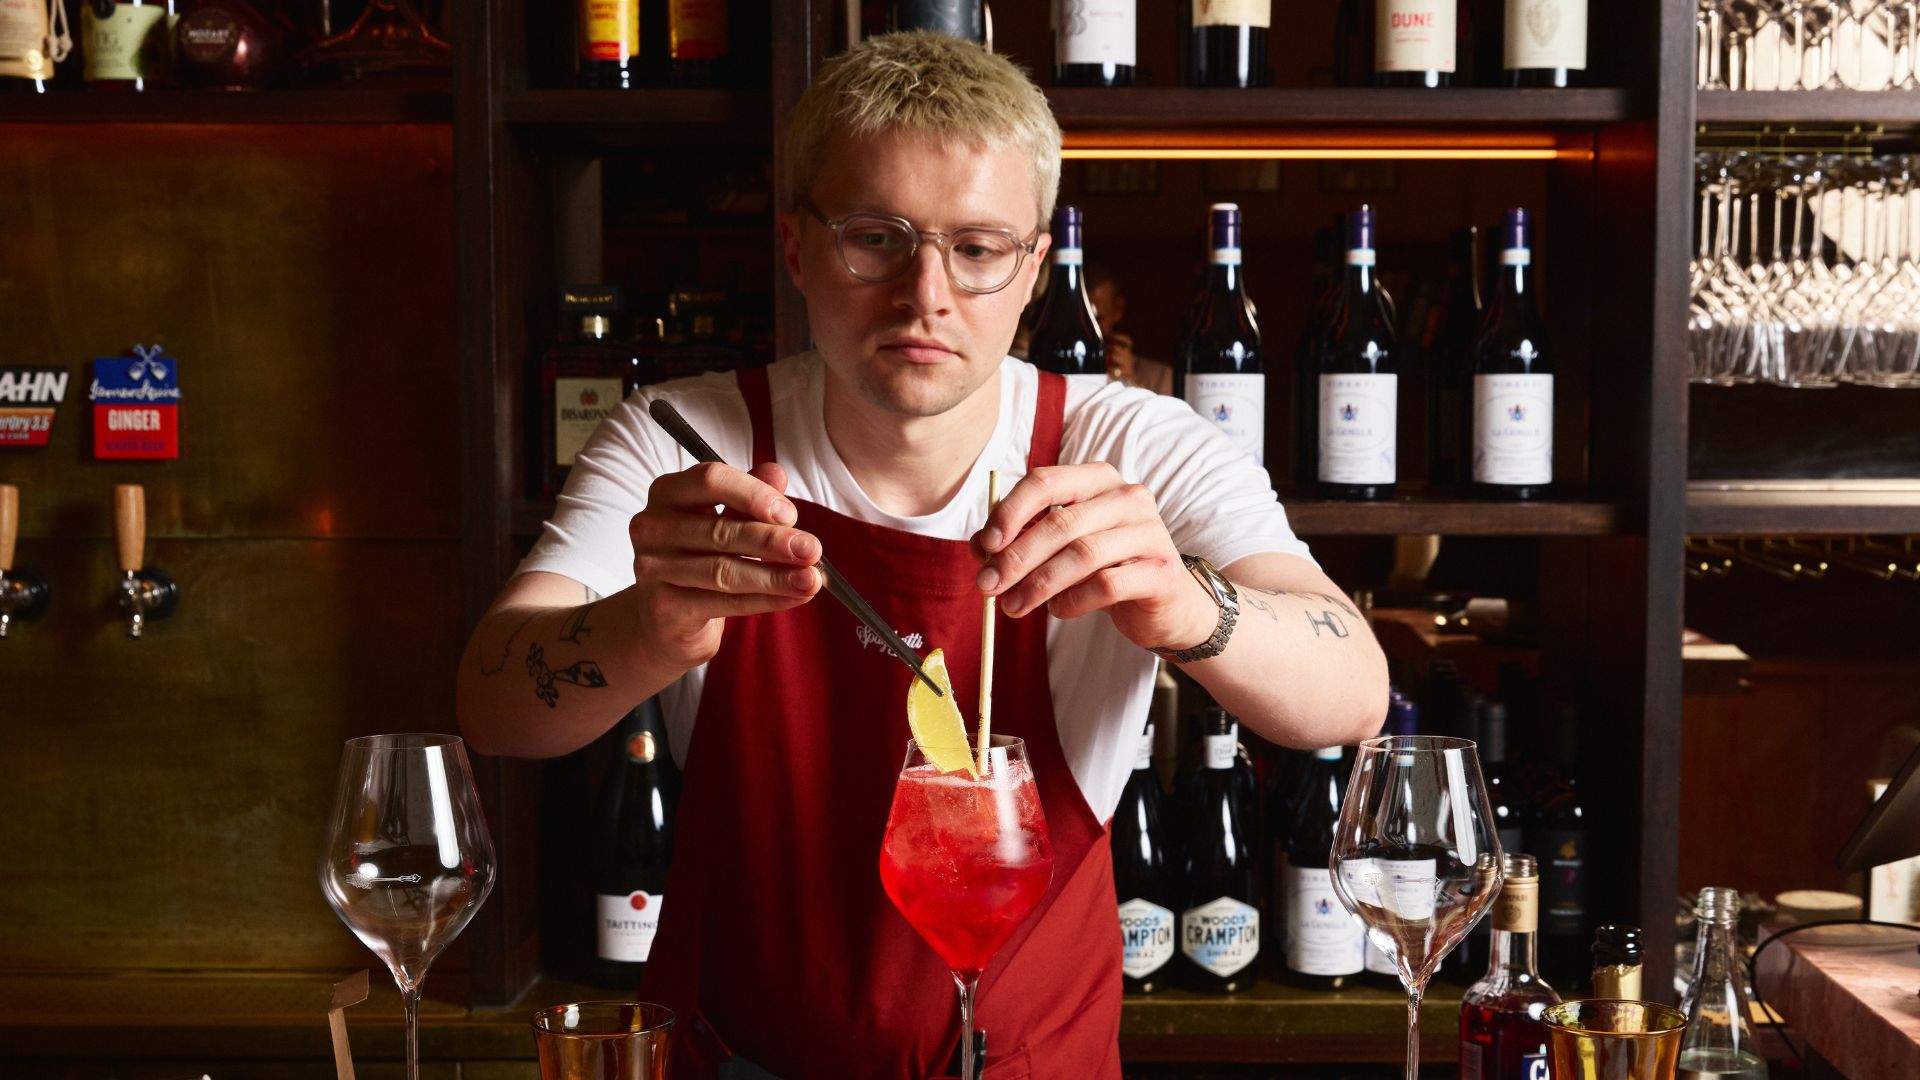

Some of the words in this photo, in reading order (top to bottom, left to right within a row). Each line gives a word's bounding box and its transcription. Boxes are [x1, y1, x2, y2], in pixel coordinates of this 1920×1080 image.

[1391, 12, 1435, 29] DUNE
[0, 371, 69, 402] AHN
[107, 409, 161, 432] GINGER
[560, 408, 609, 422] DISARON
[856, 625, 923, 653] Spatti
[1120, 916, 1160, 927] OODS
[1201, 915, 1247, 926] WOODS
[1120, 927, 1170, 947] AMPTON
[1186, 924, 1256, 946] CRAMPTON
